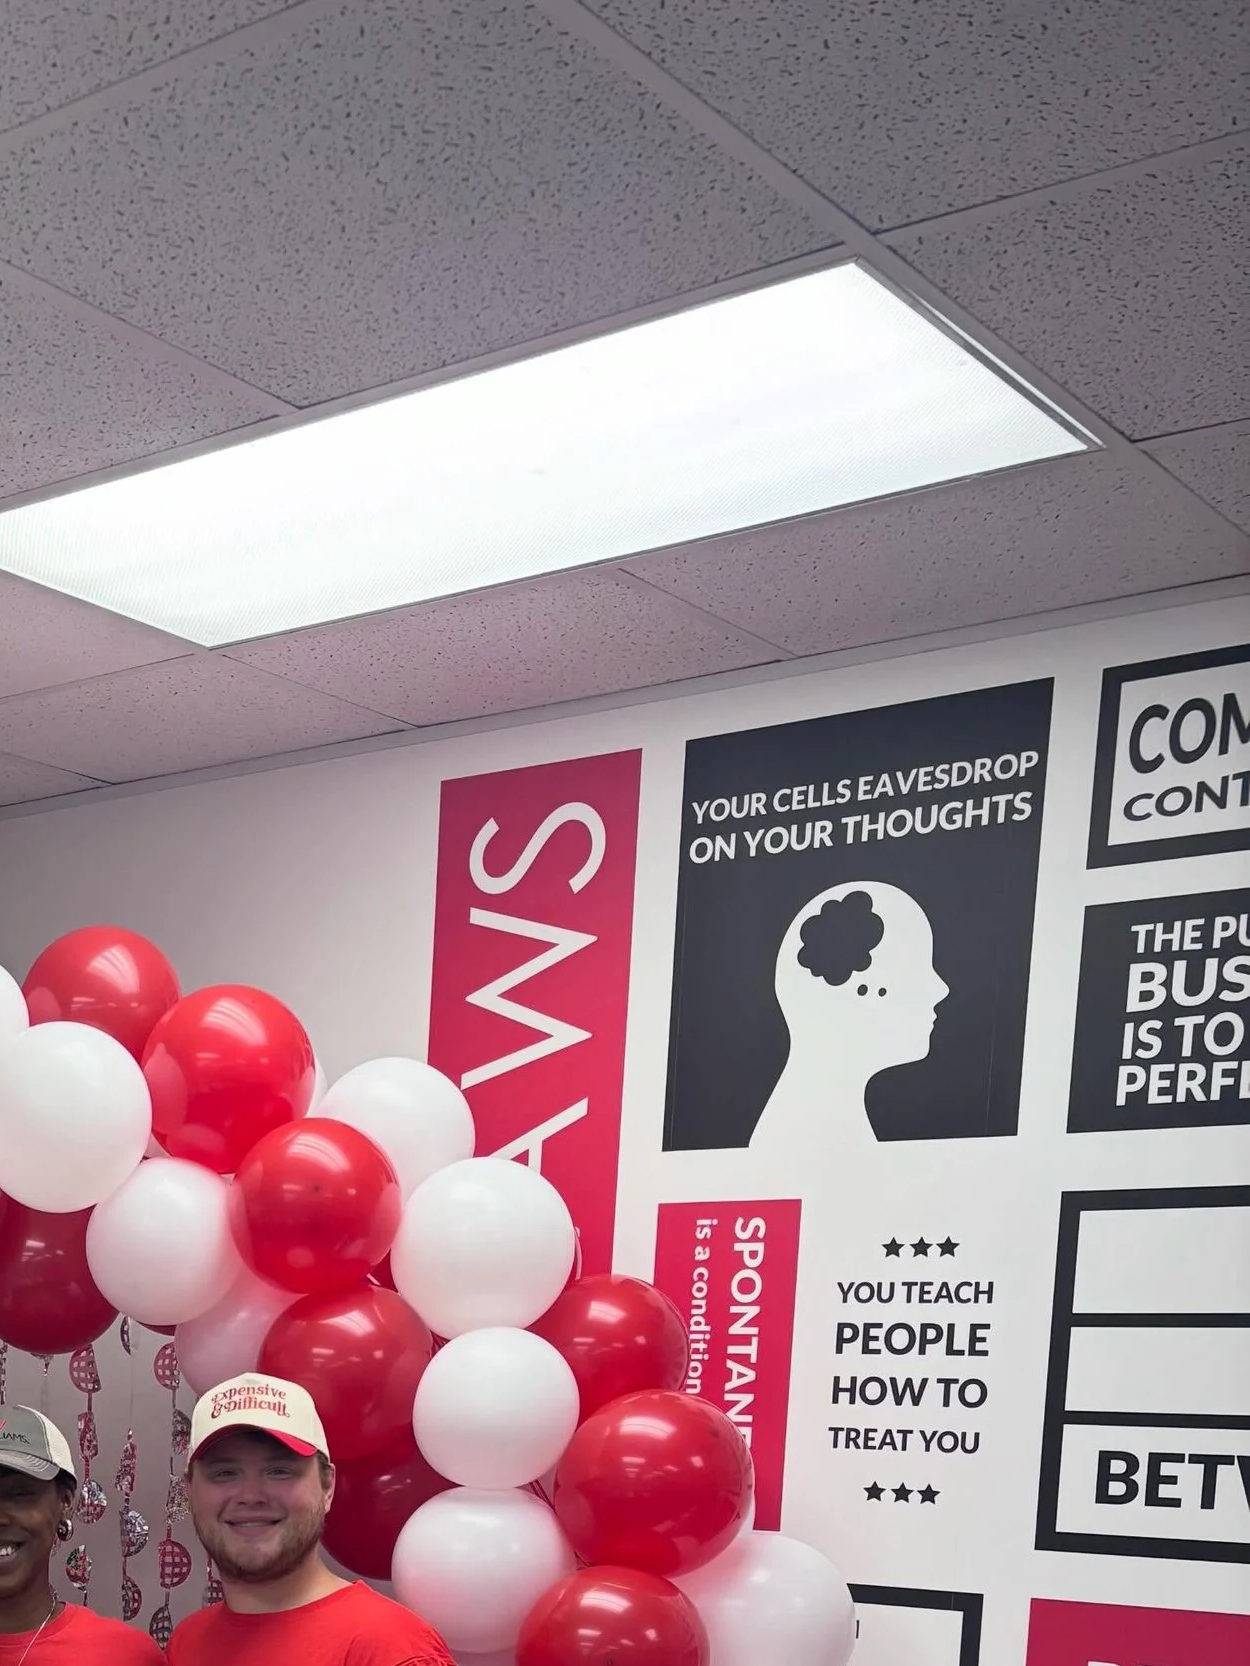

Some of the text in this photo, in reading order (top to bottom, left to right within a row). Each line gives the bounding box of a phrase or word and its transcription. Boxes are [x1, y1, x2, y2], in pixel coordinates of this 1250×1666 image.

[691, 751, 1039, 825] YOUR CELLS EAVESDROP
[689, 791, 1033, 864] ON YOUR THOUGHTS
[1130, 918, 1205, 954] THE
[1125, 955, 1250, 1013] BUS
[1121, 1011, 1245, 1060] IS TO
[694, 1218, 718, 1239] is
[694, 1245, 711, 1261] a
[837, 1281, 994, 1304] YOU TEACH
[835, 1322, 991, 1357] PEOPLE
[211, 1384, 287, 1403] Expensive
[831, 1376, 988, 1408] HOW TO
[828, 1426, 981, 1454] TREAT YOU
[1094, 1450, 1250, 1511] BET
